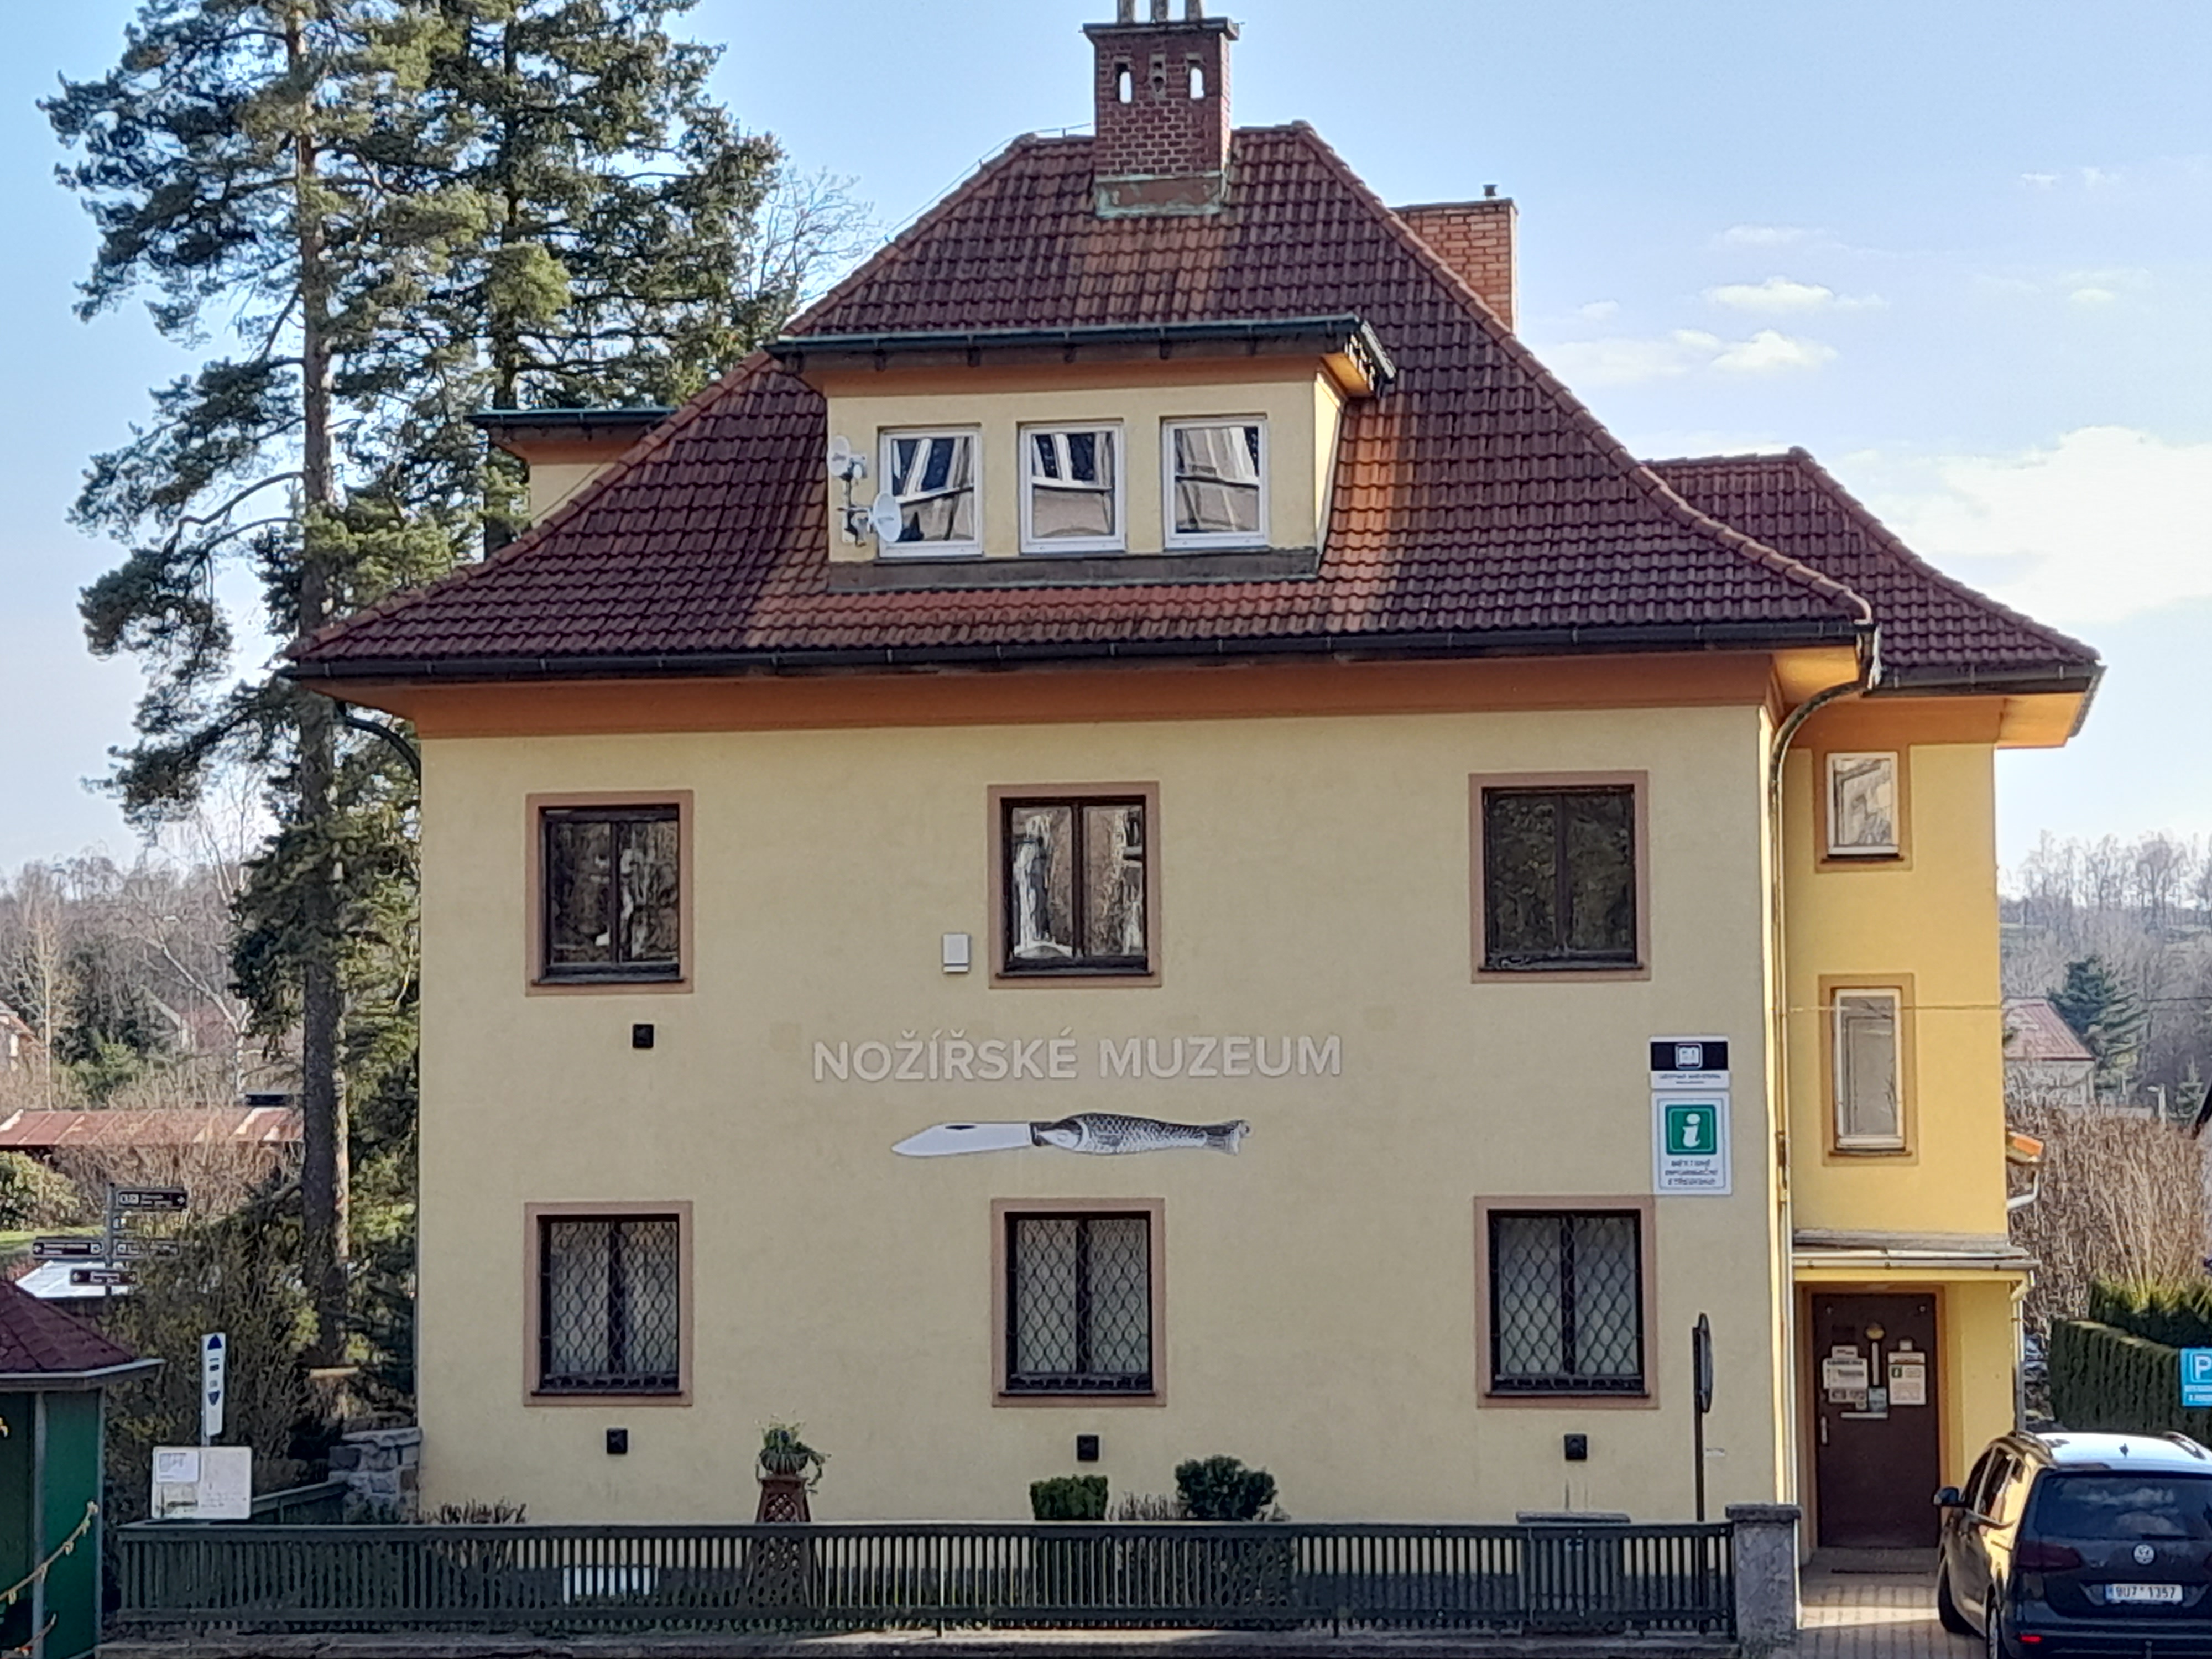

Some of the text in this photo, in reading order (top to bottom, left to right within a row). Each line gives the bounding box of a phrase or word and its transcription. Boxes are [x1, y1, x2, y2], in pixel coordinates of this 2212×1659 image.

[813, 1026, 1342, 1081] NOŽÍŘSKÉ MUZEUM
[2194, 1355, 2212, 1380] P
